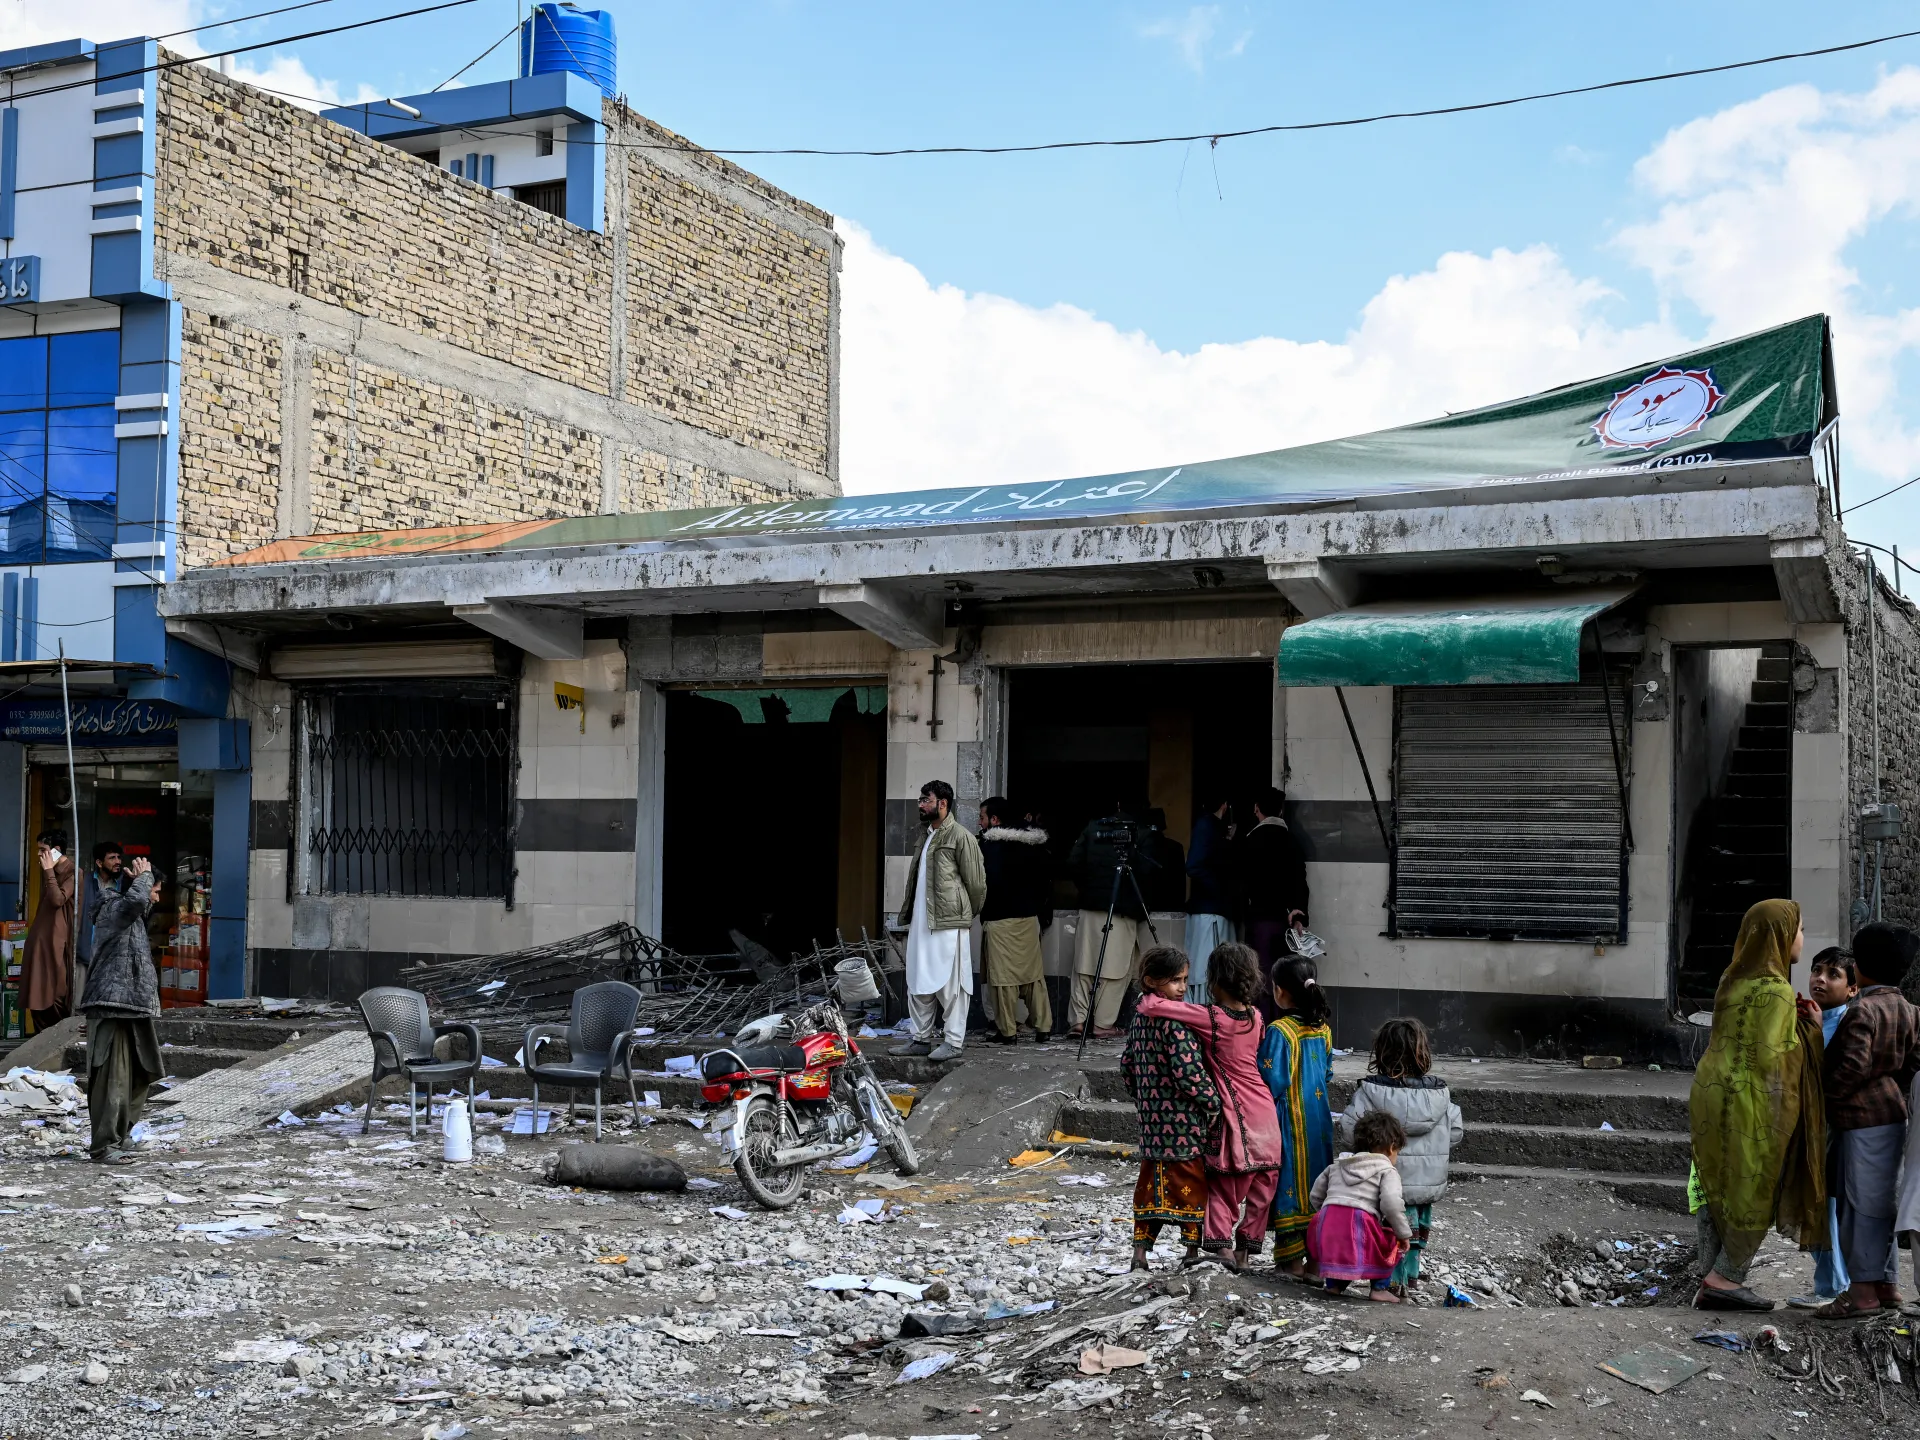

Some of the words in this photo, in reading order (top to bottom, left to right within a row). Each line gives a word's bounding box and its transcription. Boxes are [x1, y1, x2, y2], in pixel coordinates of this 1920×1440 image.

[1632, 384, 1686, 417] سود
[1536, 467, 1582, 481] Ganji
[1587, 461, 1651, 475] Branch
[1656, 452, 1713, 470] (2107)
[669, 487, 991, 532] Aitemaad
[971, 467, 1183, 513] اعتماد
